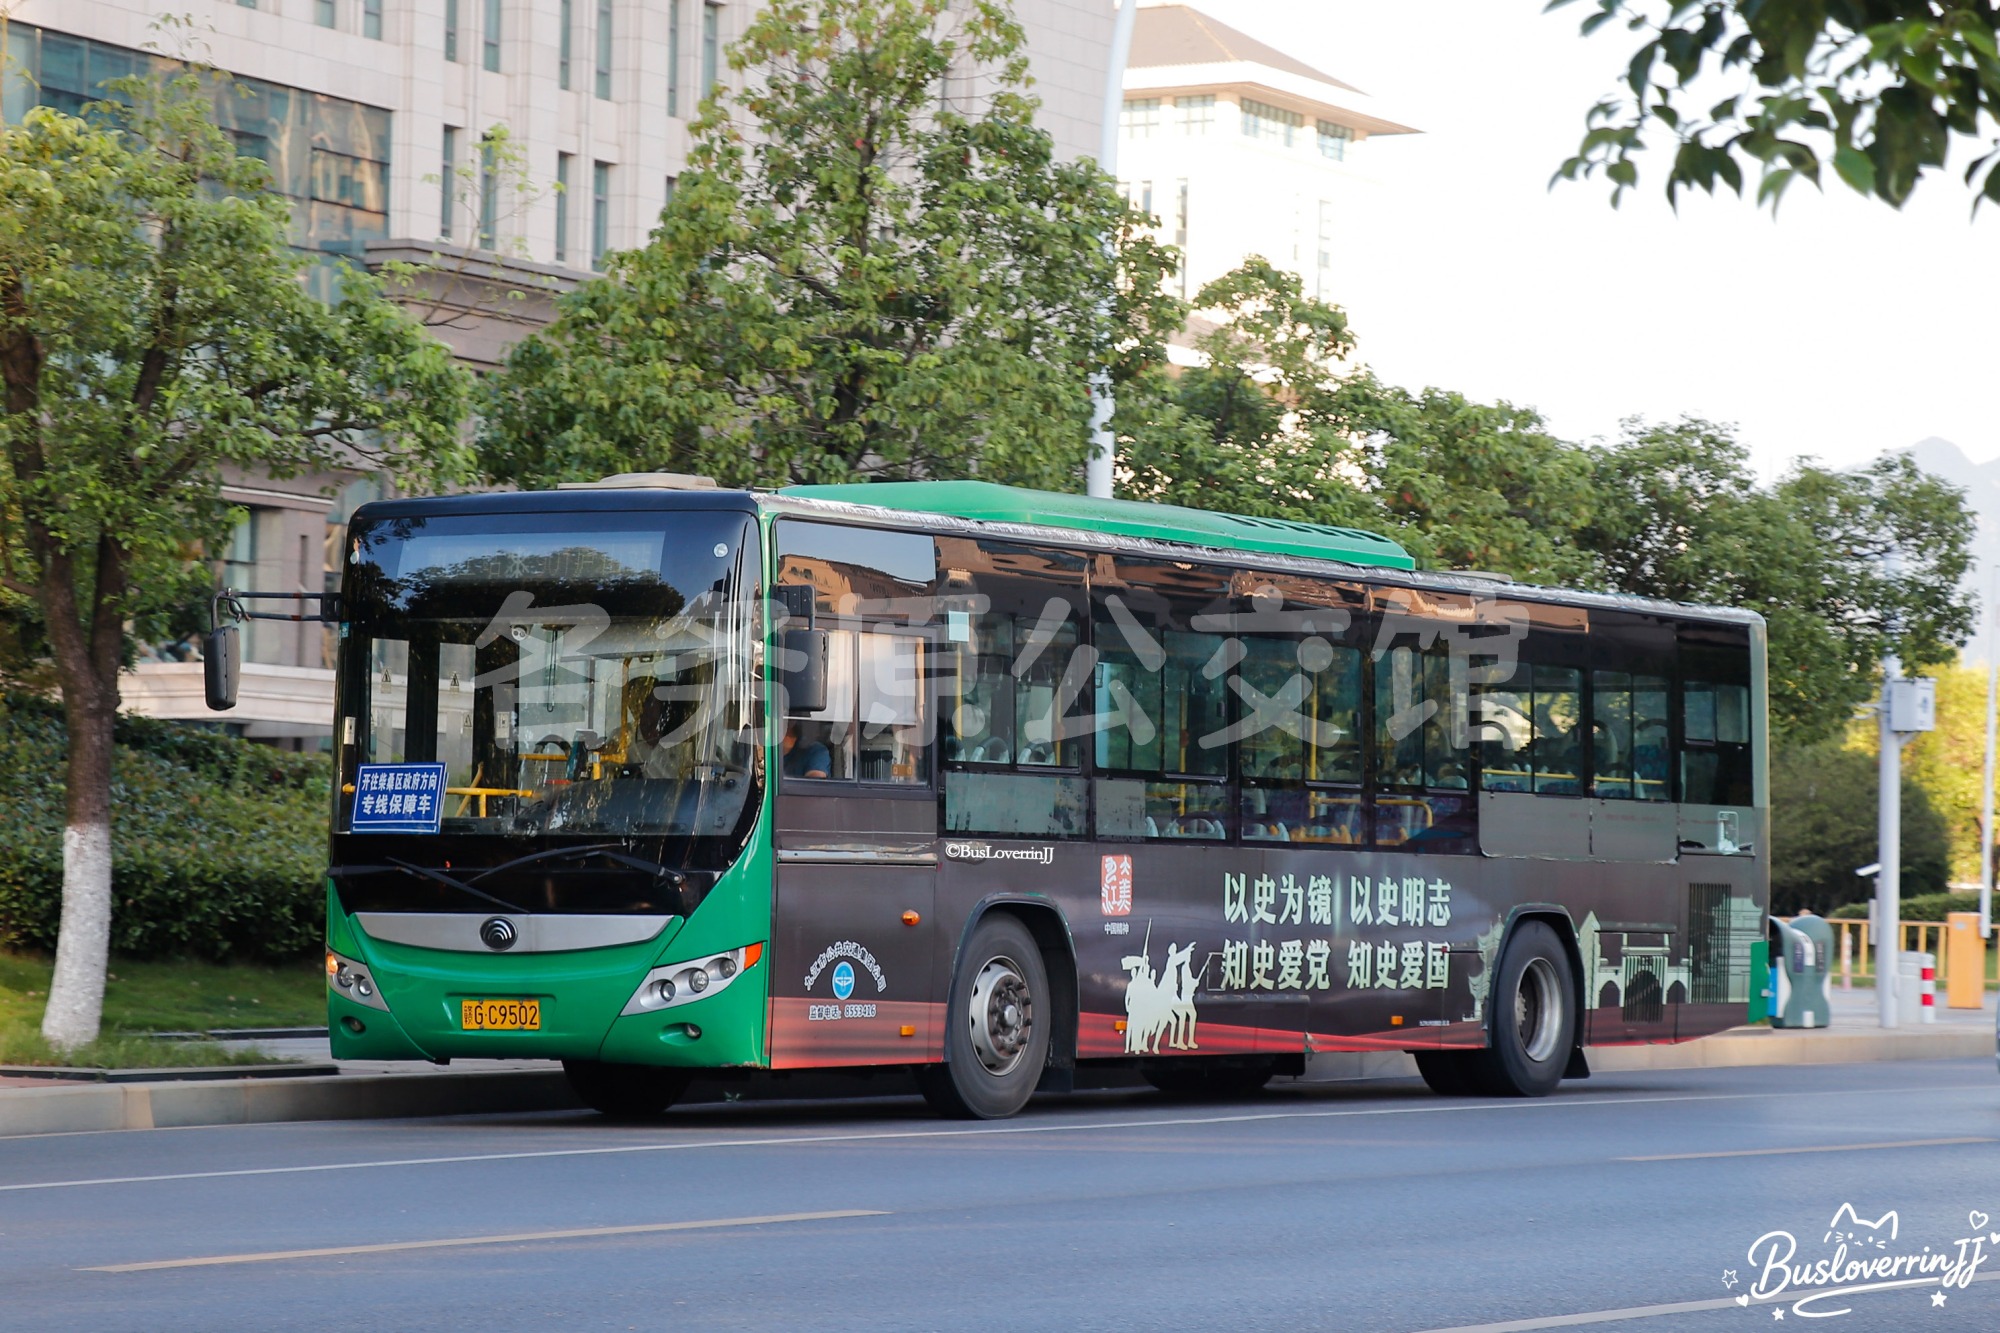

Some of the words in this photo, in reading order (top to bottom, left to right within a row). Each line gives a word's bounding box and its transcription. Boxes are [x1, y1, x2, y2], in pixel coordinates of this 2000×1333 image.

[361, 771, 438, 793] 开往柴桑区政府方向
[361, 793, 432, 815] 专线保障车
[1223, 872, 1333, 925] 以史为镜
[1350, 875, 1452, 927] 以史明志
[1220, 938, 1331, 991] 知史爱党
[1347, 940, 1450, 990] 知史爱国
